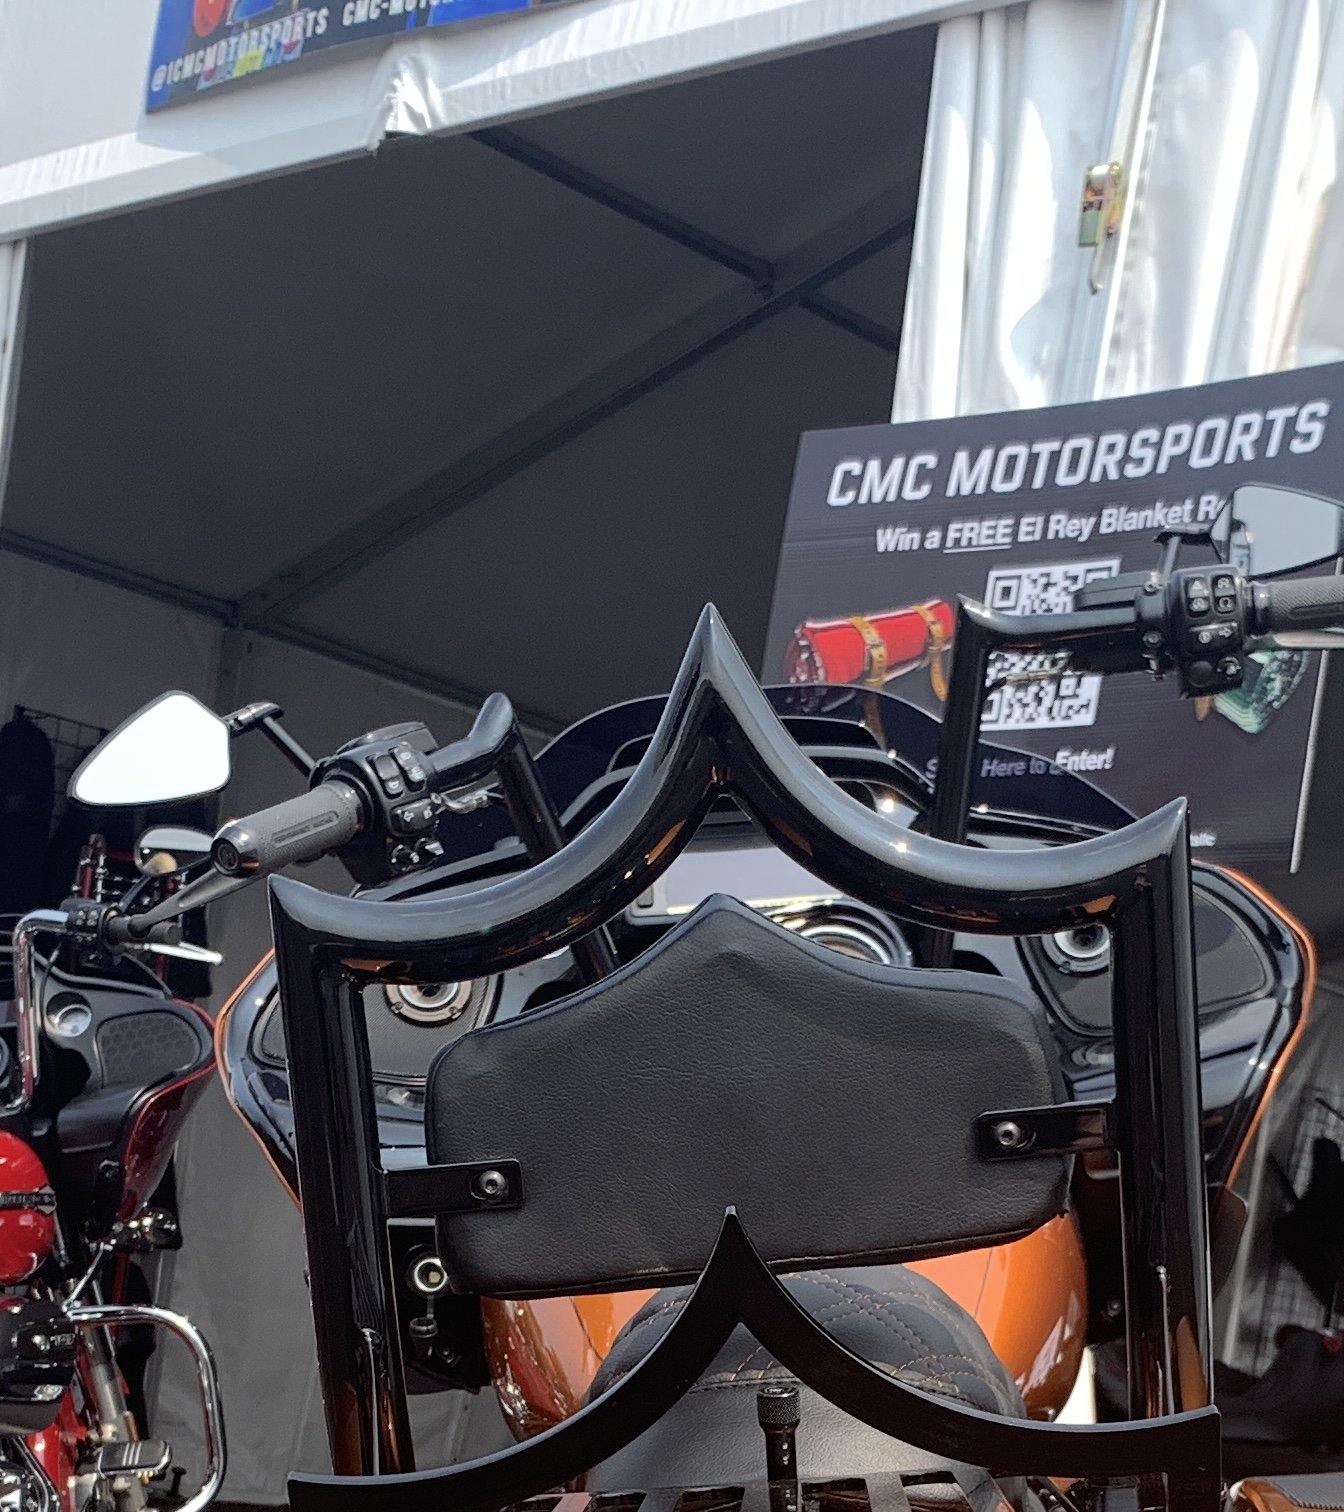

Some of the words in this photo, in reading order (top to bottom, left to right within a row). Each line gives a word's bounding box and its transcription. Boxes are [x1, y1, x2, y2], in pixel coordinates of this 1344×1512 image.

[826, 454, 938, 507] CMC
[945, 401, 1331, 497] MOTORSPORTS
[876, 526, 921, 552] Win
[924, 529, 941, 549] a
[945, 518, 1014, 549] FREE
[1047, 513, 1096, 543] Rey
[1099, 499, 1194, 534] Blanket
[980, 758, 1026, 777] Here
